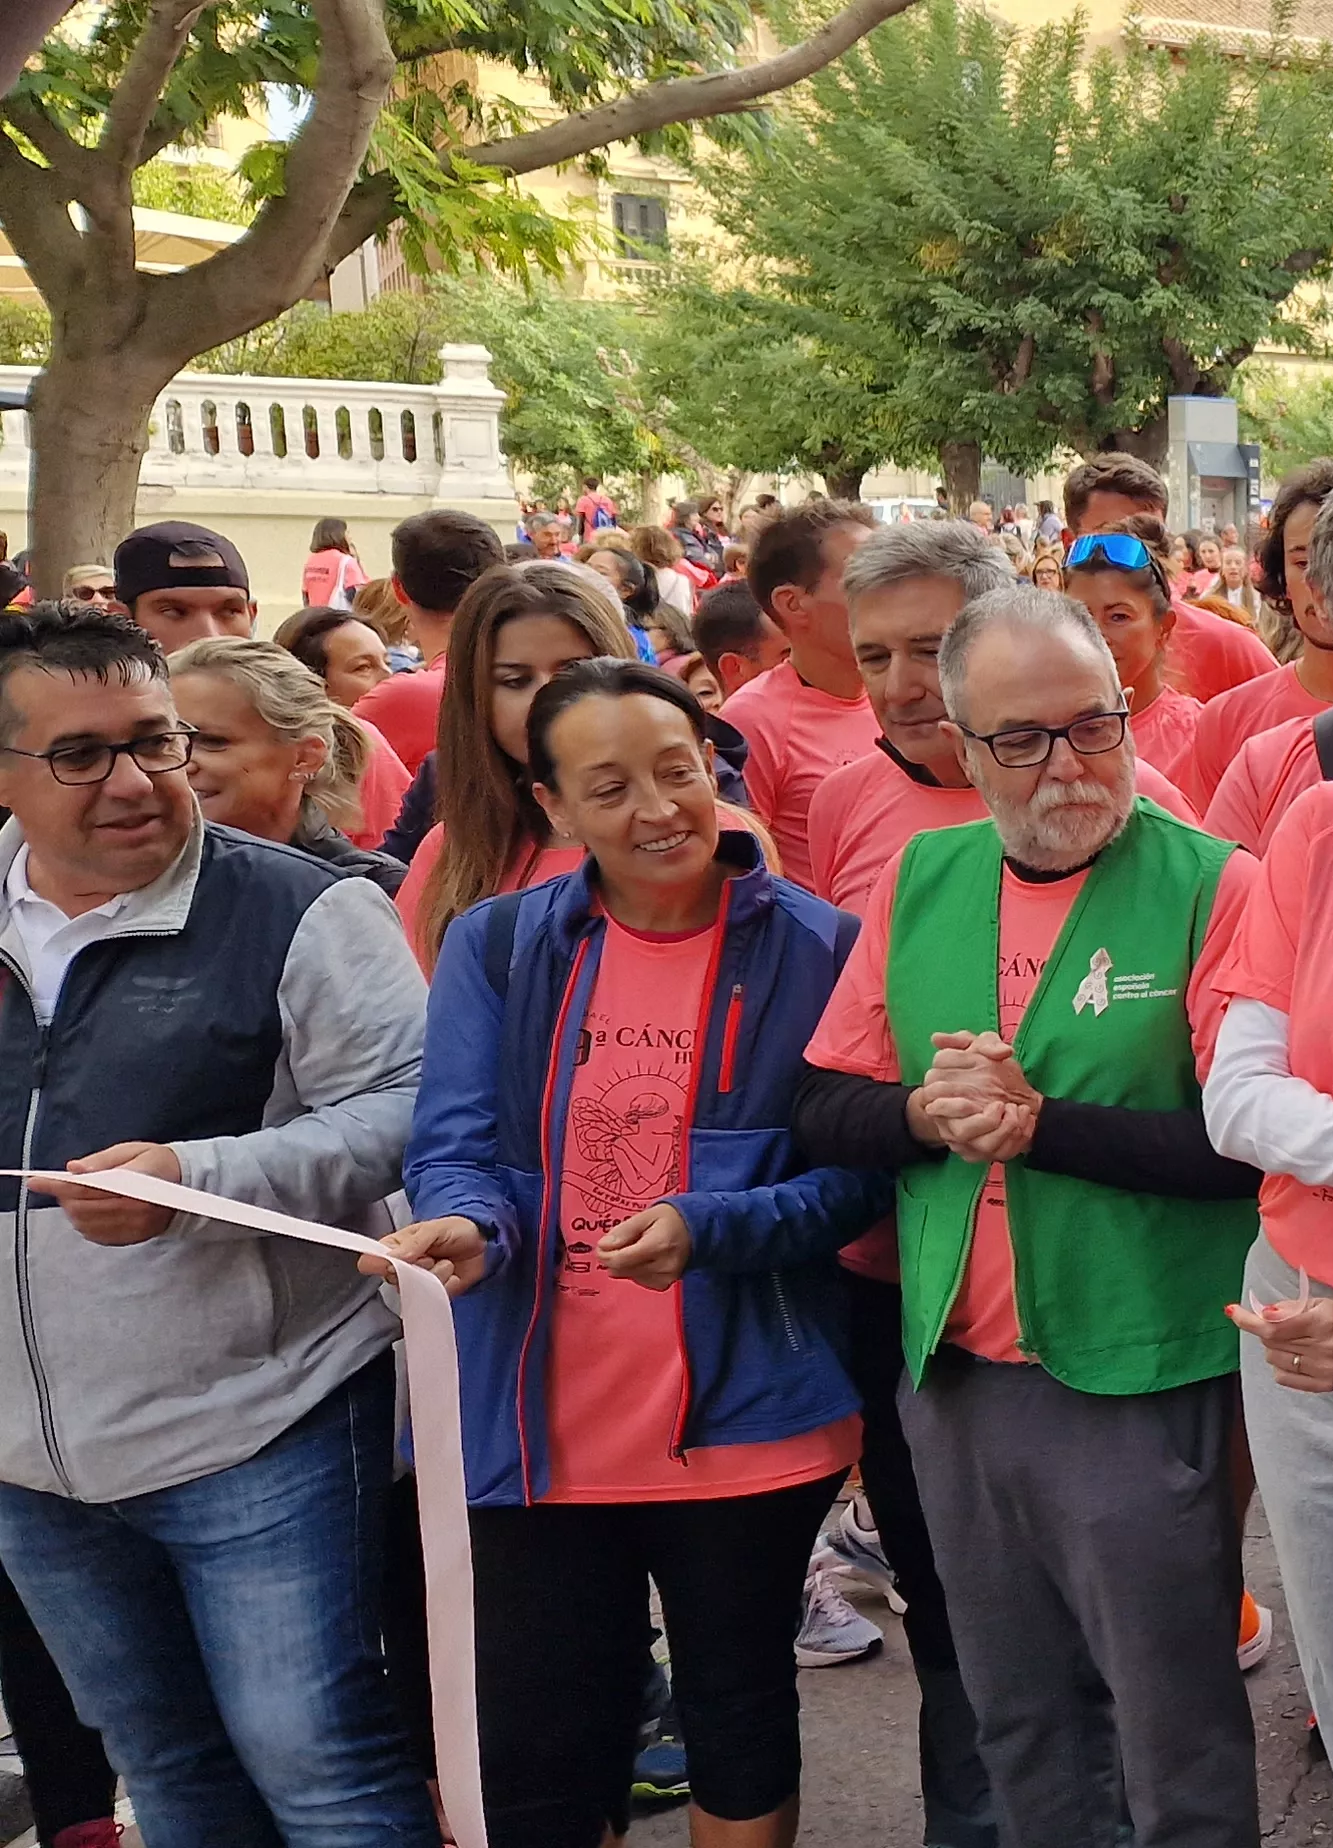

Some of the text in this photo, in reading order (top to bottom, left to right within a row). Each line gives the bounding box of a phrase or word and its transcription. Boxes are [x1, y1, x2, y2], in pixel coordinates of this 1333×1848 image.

[999, 953, 1046, 977] CÁN
[616, 1023, 698, 1049] CÁNC
[571, 1213, 632, 1233] QUIÉR
